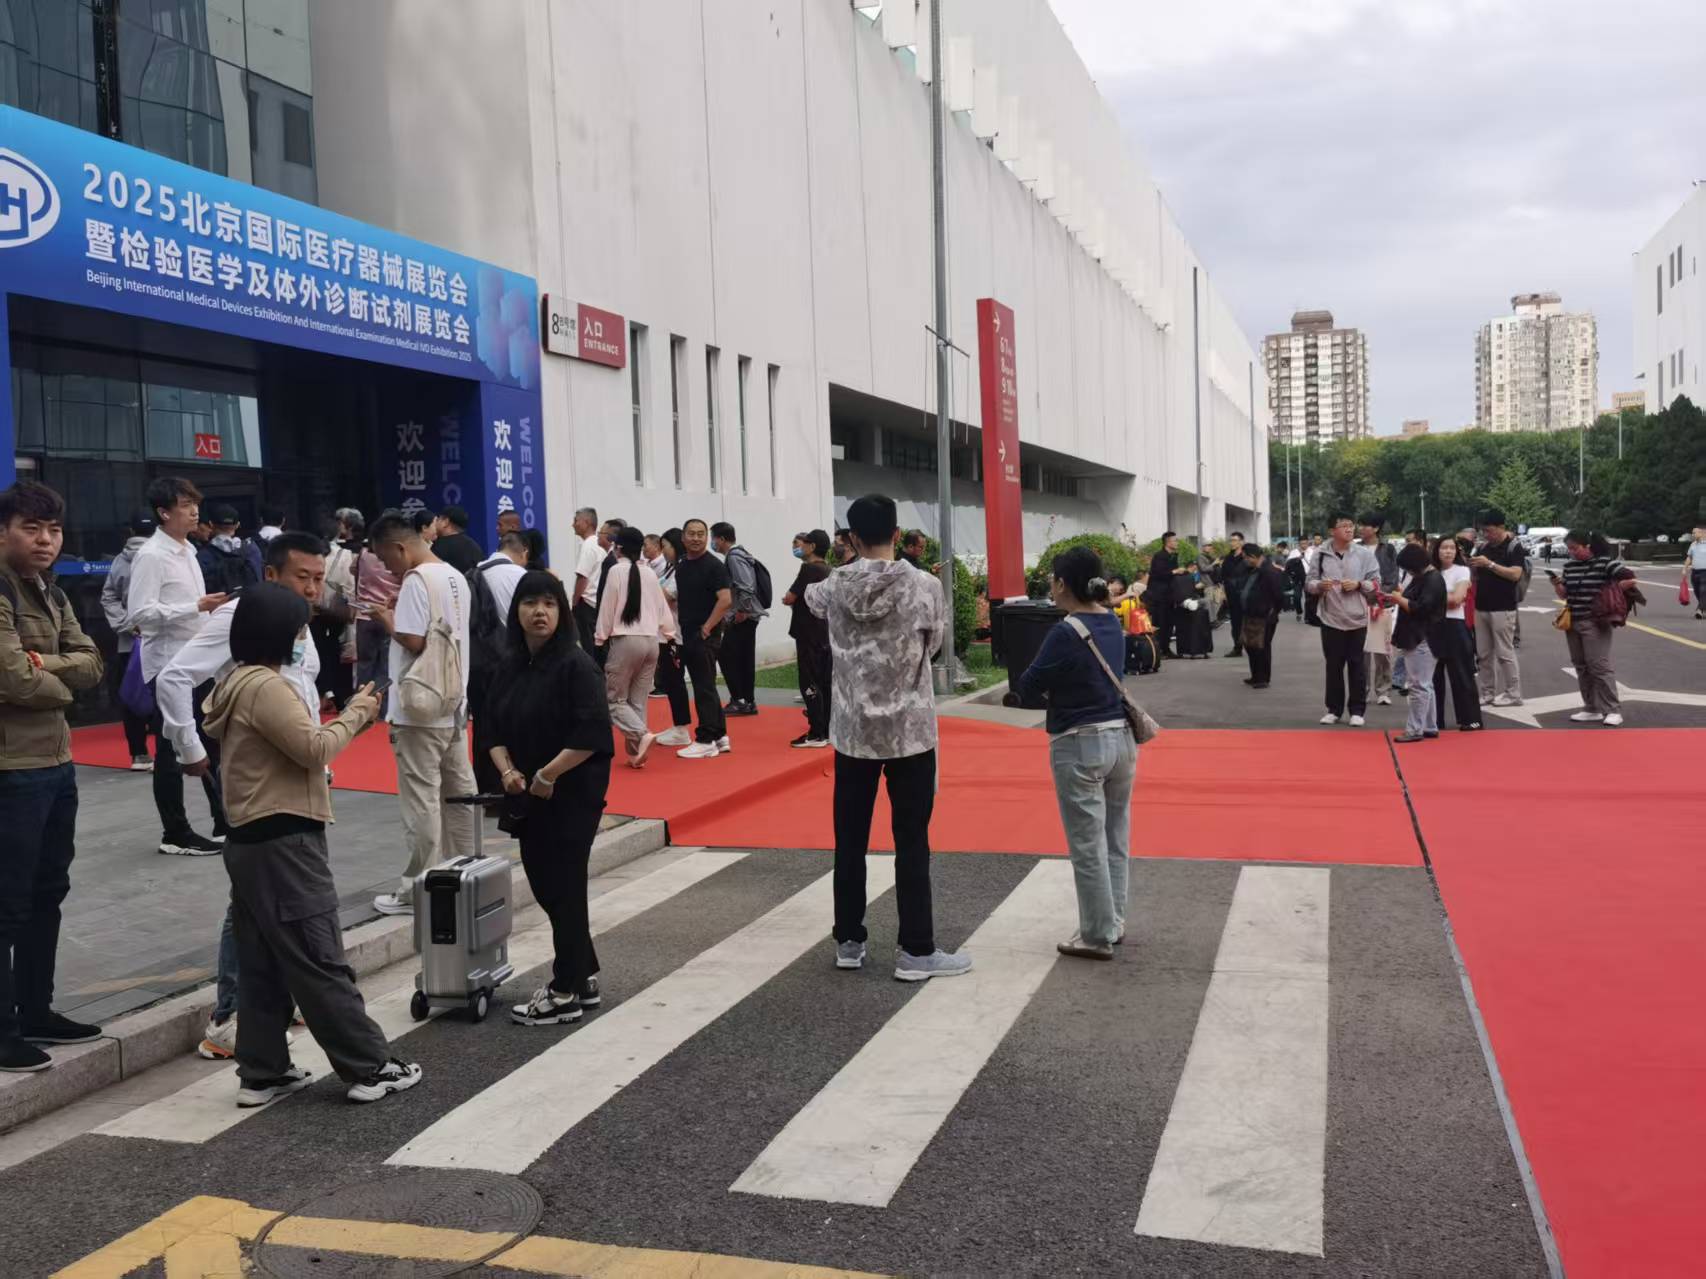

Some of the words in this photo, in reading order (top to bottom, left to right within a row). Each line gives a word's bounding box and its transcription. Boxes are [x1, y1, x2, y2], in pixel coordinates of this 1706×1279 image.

[84, 162, 468, 307] 2025北京国际医疗器械展览会
[85, 218, 470, 345] 暨检验医学及体外诊断试剂展览会
[87, 269, 122, 291] Beijing
[124, 277, 184, 301] International
[186, 291, 219, 309] Medical
[222, 299, 253, 316] Devices
[254, 306, 292, 324] Exhibition
[294, 316, 308, 328] And
[310, 319, 354, 337] International
[356, 329, 395, 346] Examination
[584, 316, 602, 338] 入口
[584, 338, 619, 356] ENTRANCE
[196, 436, 220, 454] 入口
